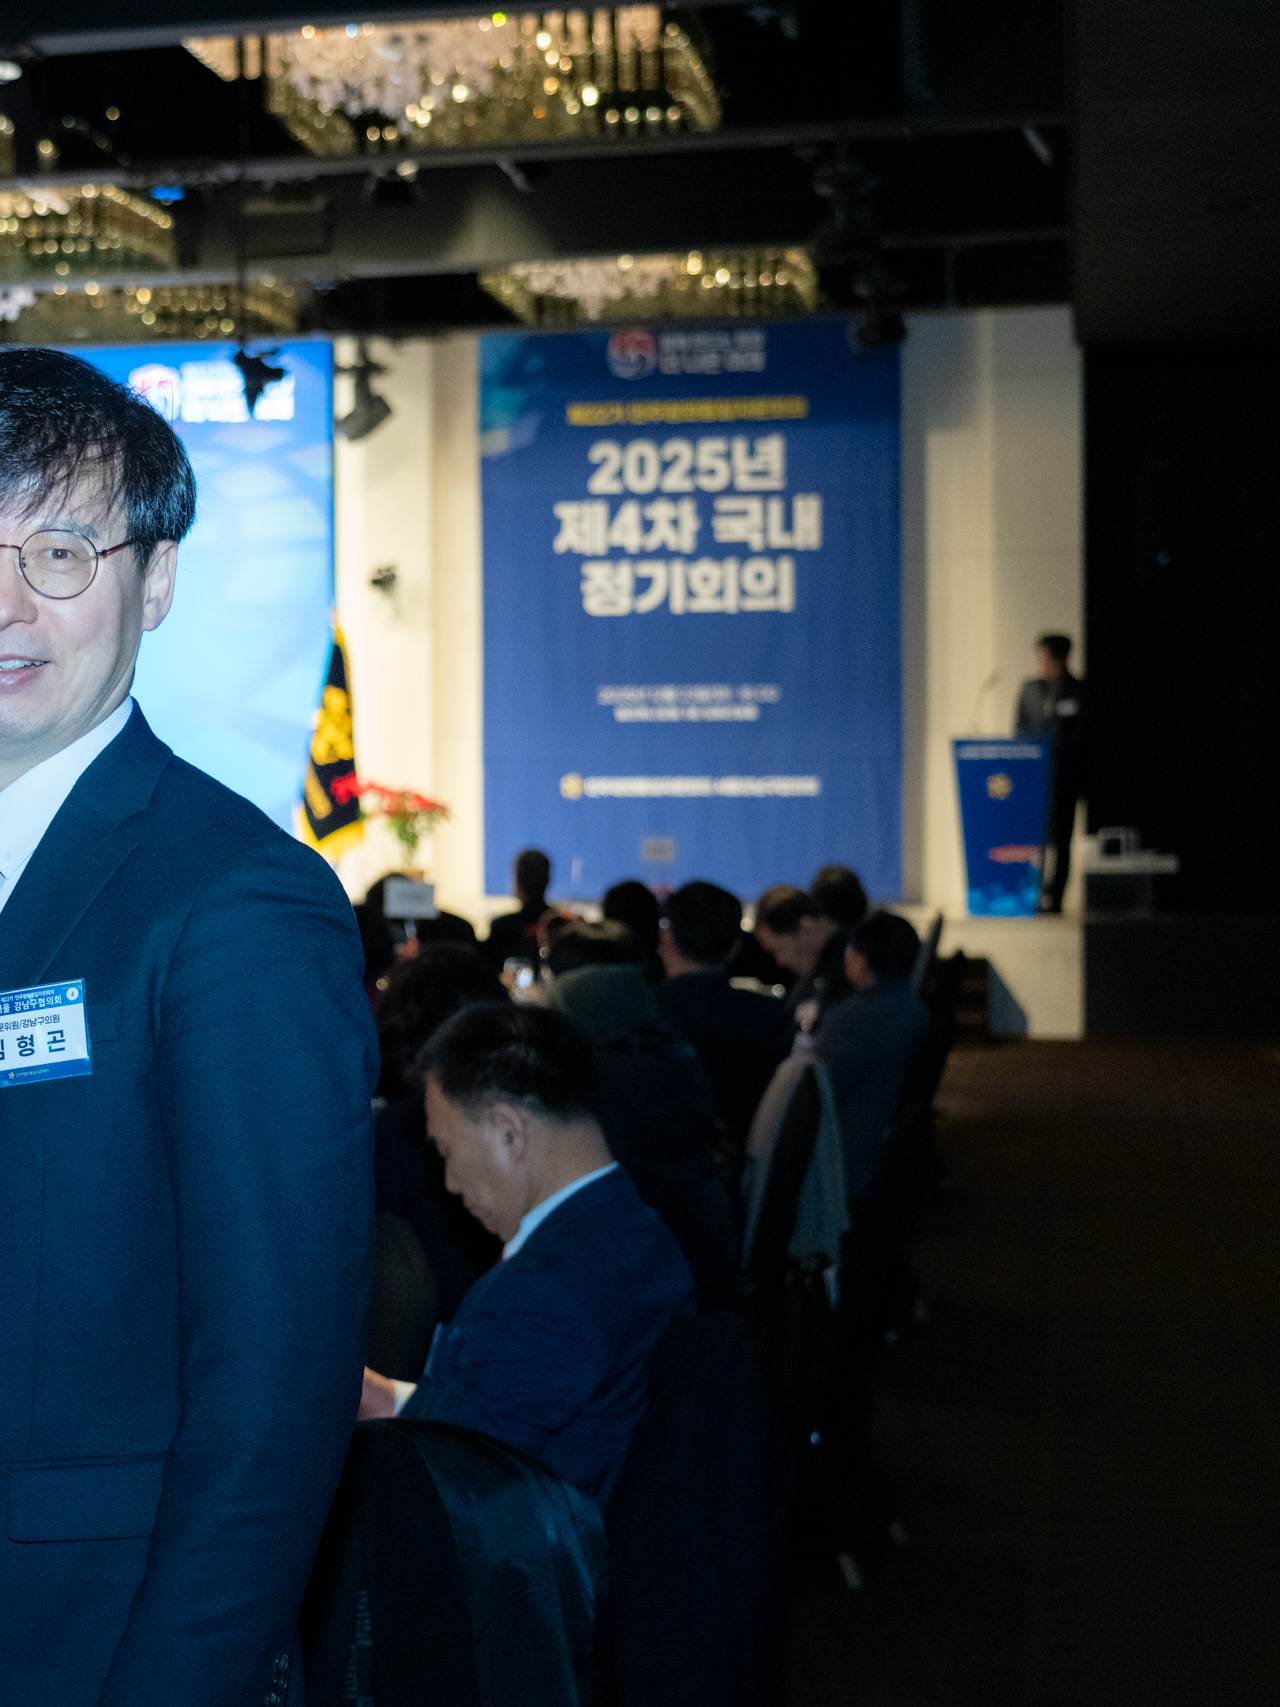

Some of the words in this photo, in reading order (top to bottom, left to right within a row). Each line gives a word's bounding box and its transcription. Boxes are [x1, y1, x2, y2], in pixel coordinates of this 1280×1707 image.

[589, 436, 785, 494] 2025년
[555, 502, 700, 555] 제4차
[714, 496, 821, 550] 국내
[582, 559, 794, 616] 정기회의
[14, 995, 62, 1012] 강남구협의회
